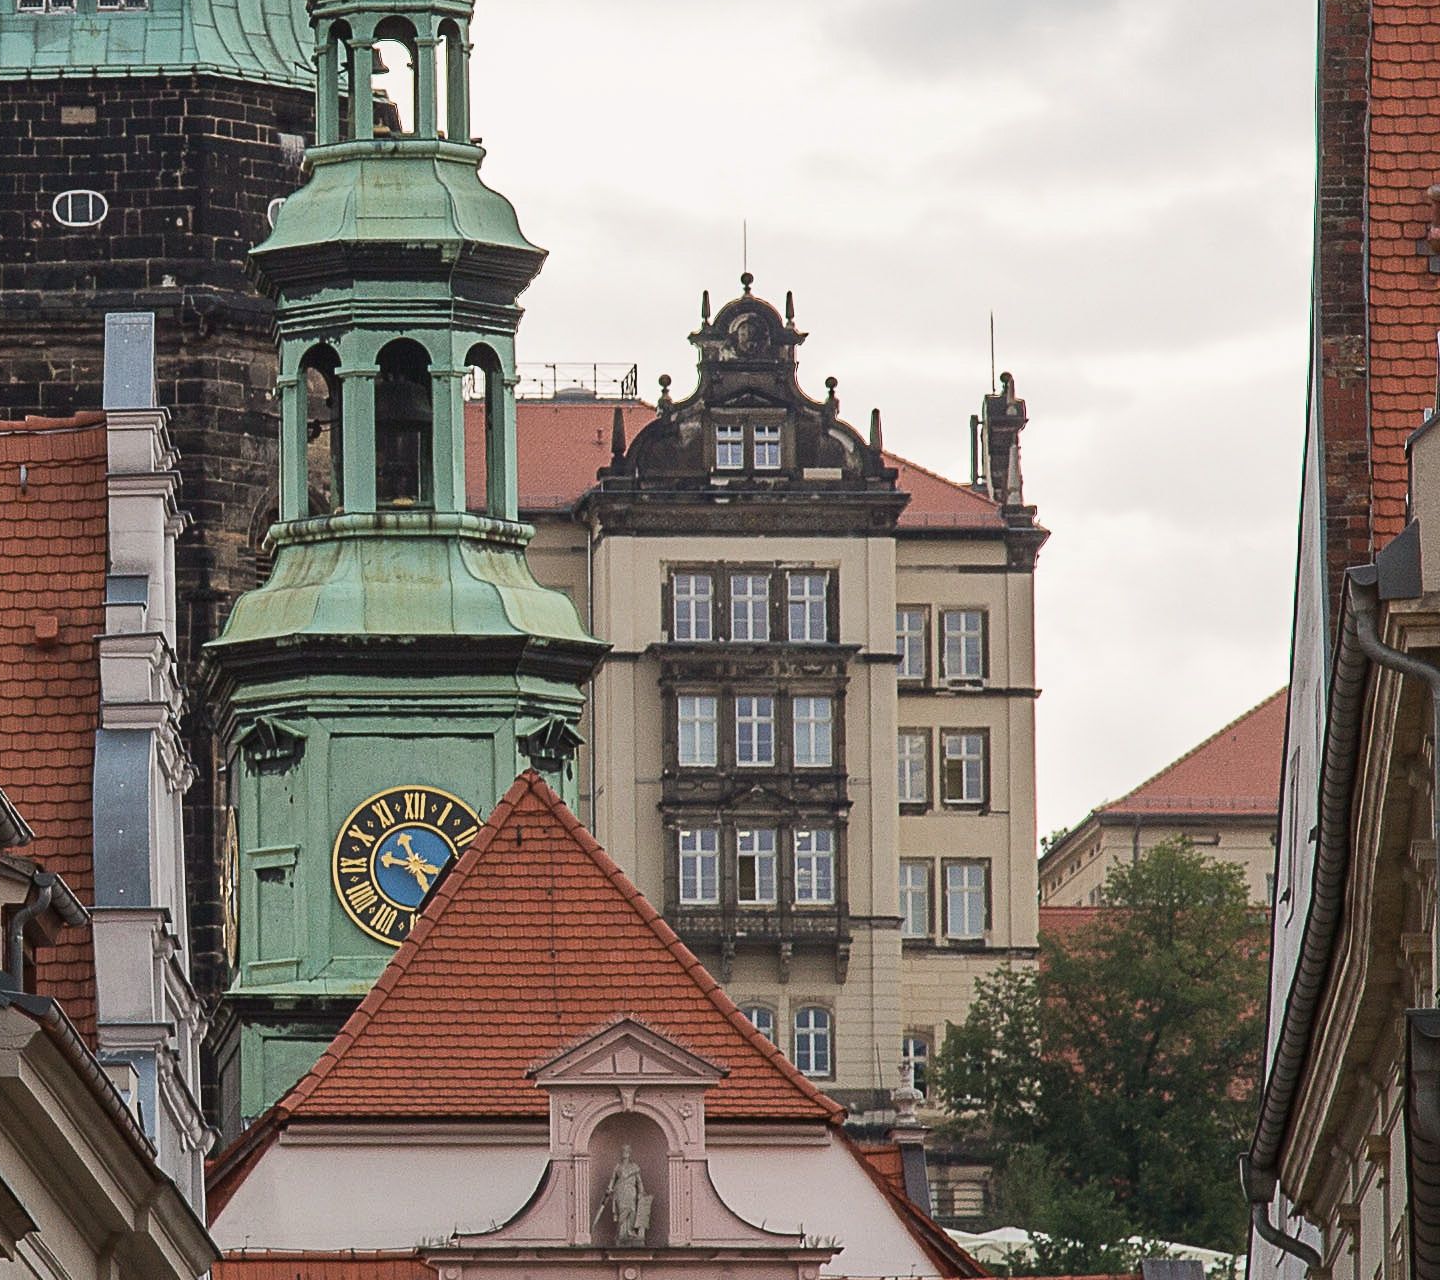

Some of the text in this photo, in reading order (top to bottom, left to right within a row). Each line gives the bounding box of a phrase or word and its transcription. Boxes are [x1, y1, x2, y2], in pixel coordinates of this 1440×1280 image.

[371, 799, 395, 828] XI
[404, 792, 427, 820] XII
[437, 802, 453, 826] I
[347, 824, 376, 848] X
